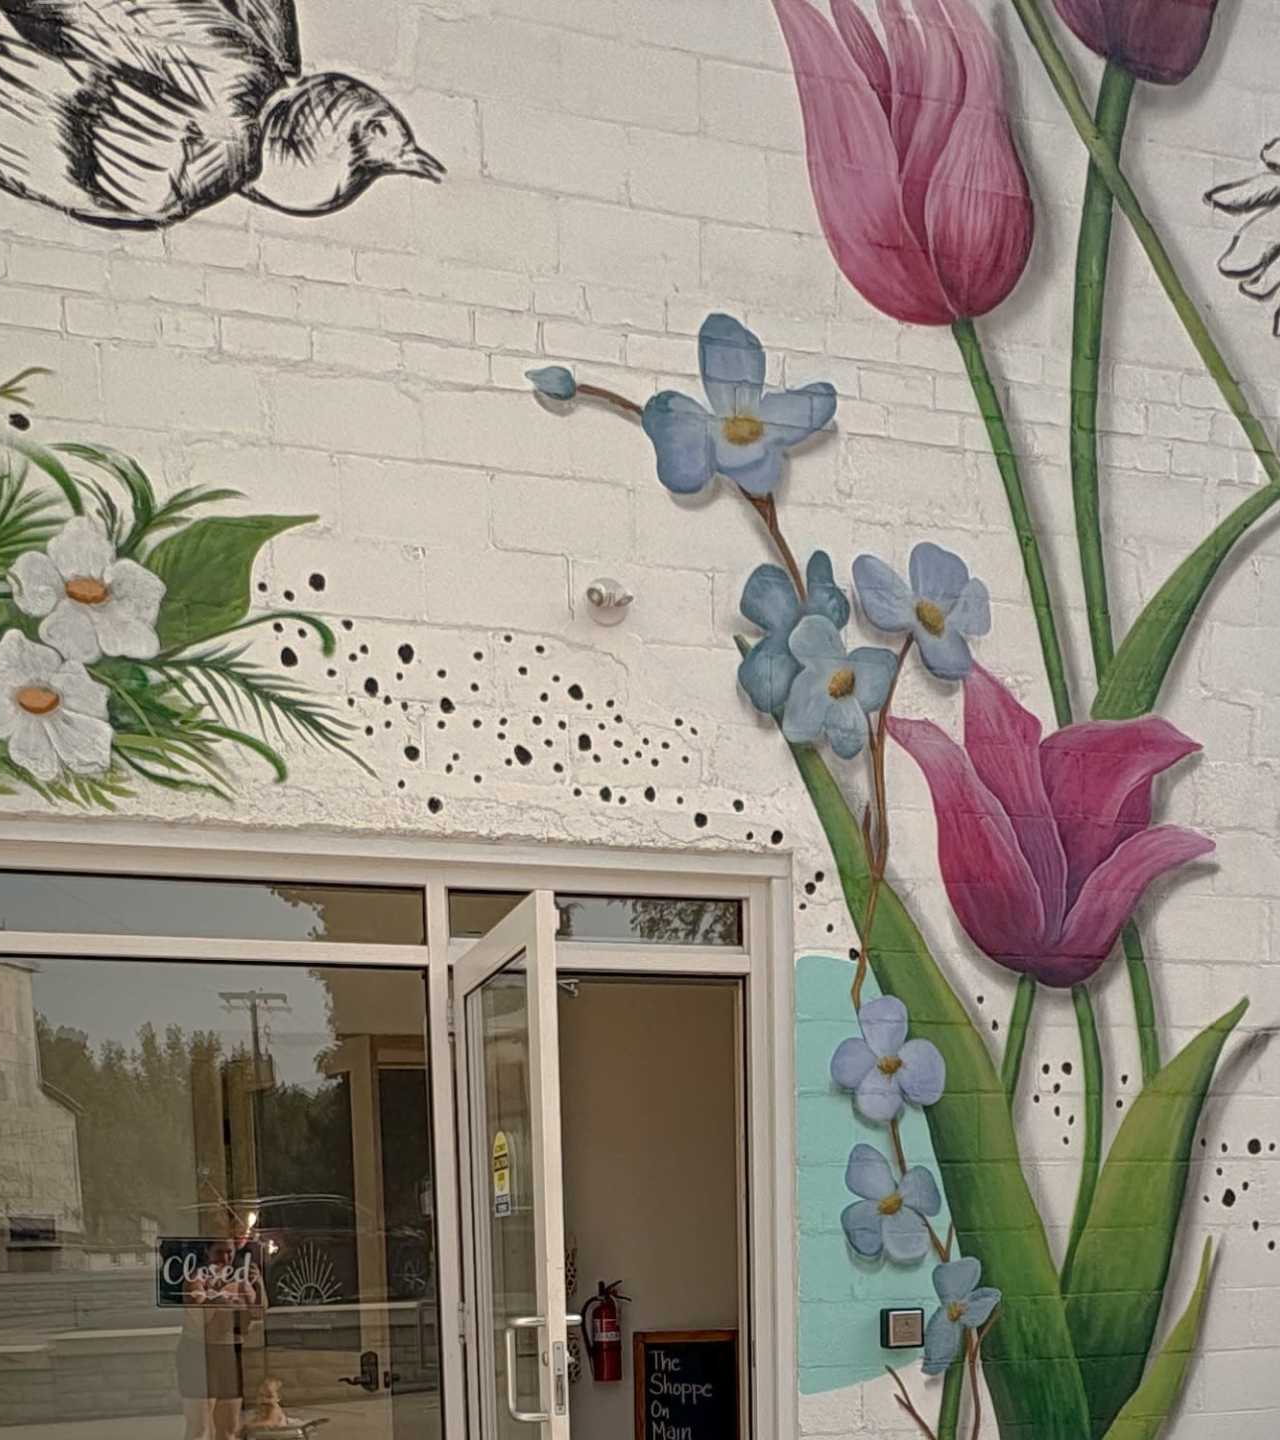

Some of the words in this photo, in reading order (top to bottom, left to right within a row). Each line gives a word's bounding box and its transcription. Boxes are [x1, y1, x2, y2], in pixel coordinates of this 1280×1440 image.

[163, 1252, 254, 1285] Closed
[649, 1350, 681, 1371] The
[649, 1372, 713, 1405] Shoppe
[650, 1400, 670, 1419] On
